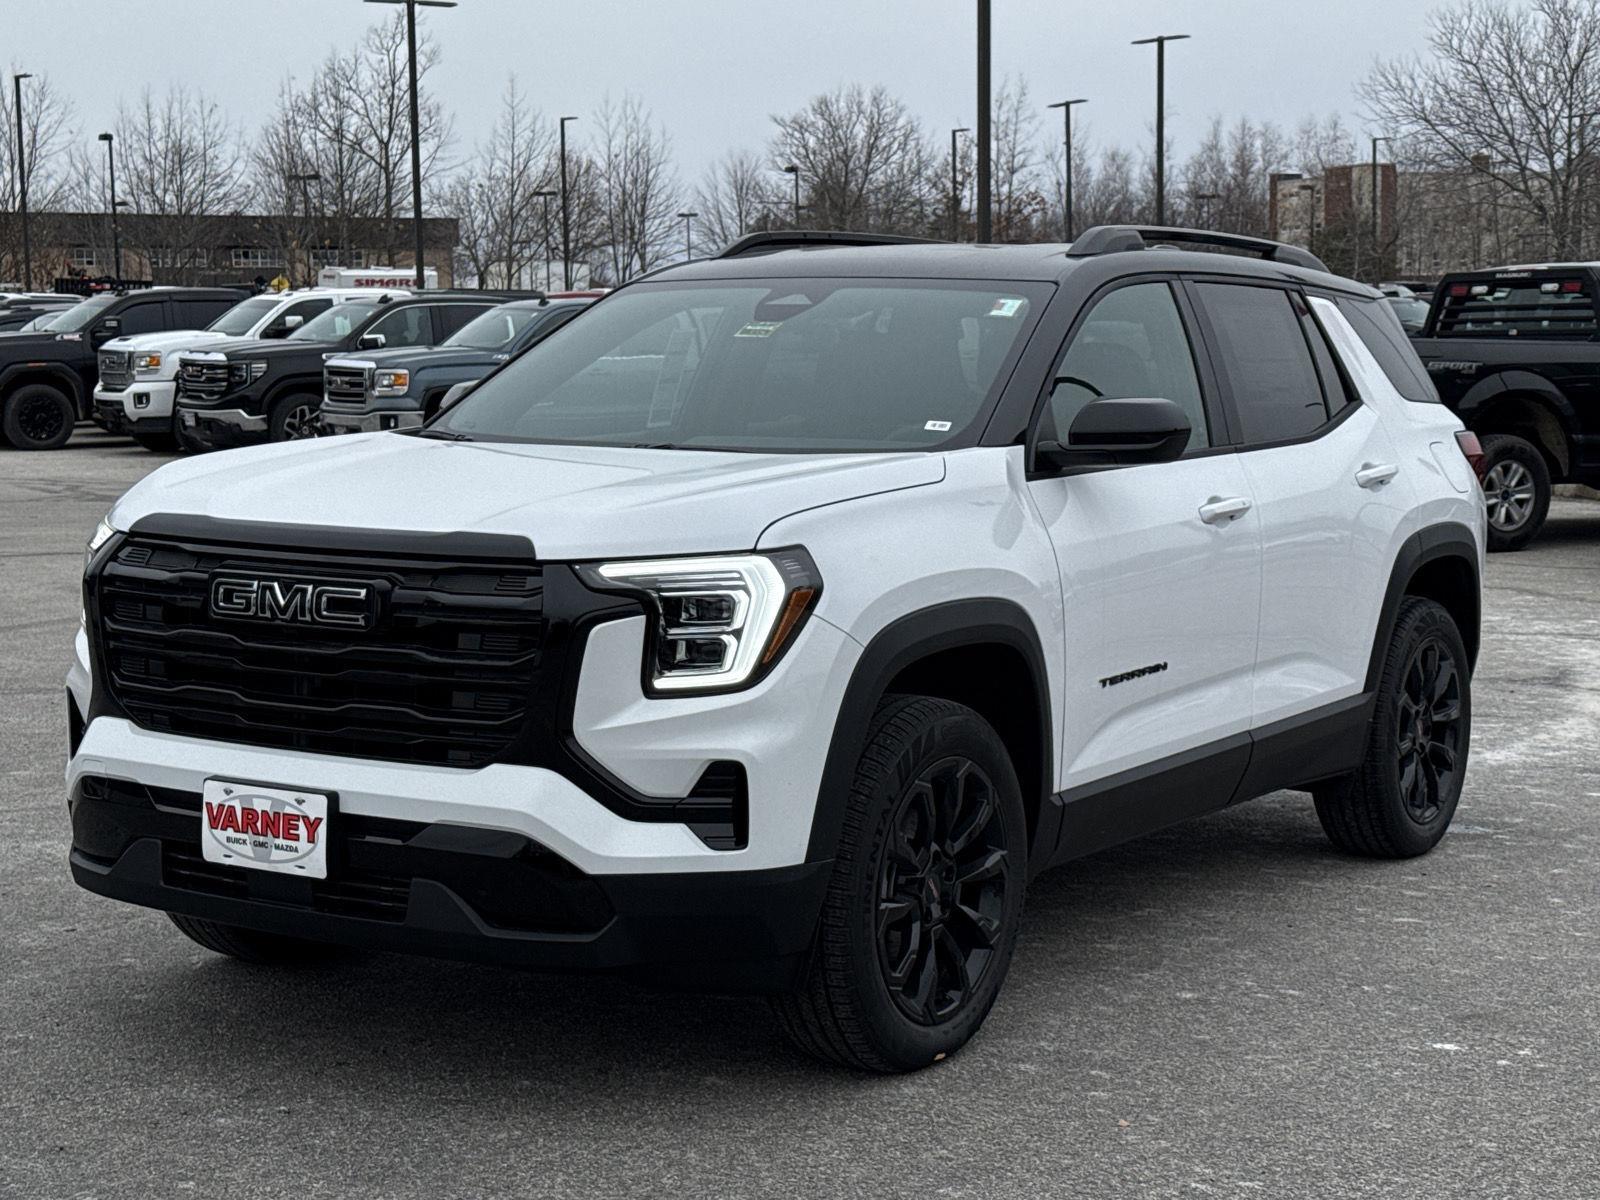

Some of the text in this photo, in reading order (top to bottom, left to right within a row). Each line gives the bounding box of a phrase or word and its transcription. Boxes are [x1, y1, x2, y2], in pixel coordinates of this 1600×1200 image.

[354, 278, 419, 287] SIMAR
[211, 577, 367, 626] GMC
[205, 801, 323, 844] VARNEY
[226, 835, 299, 854] BUICK GMC MAZDA
